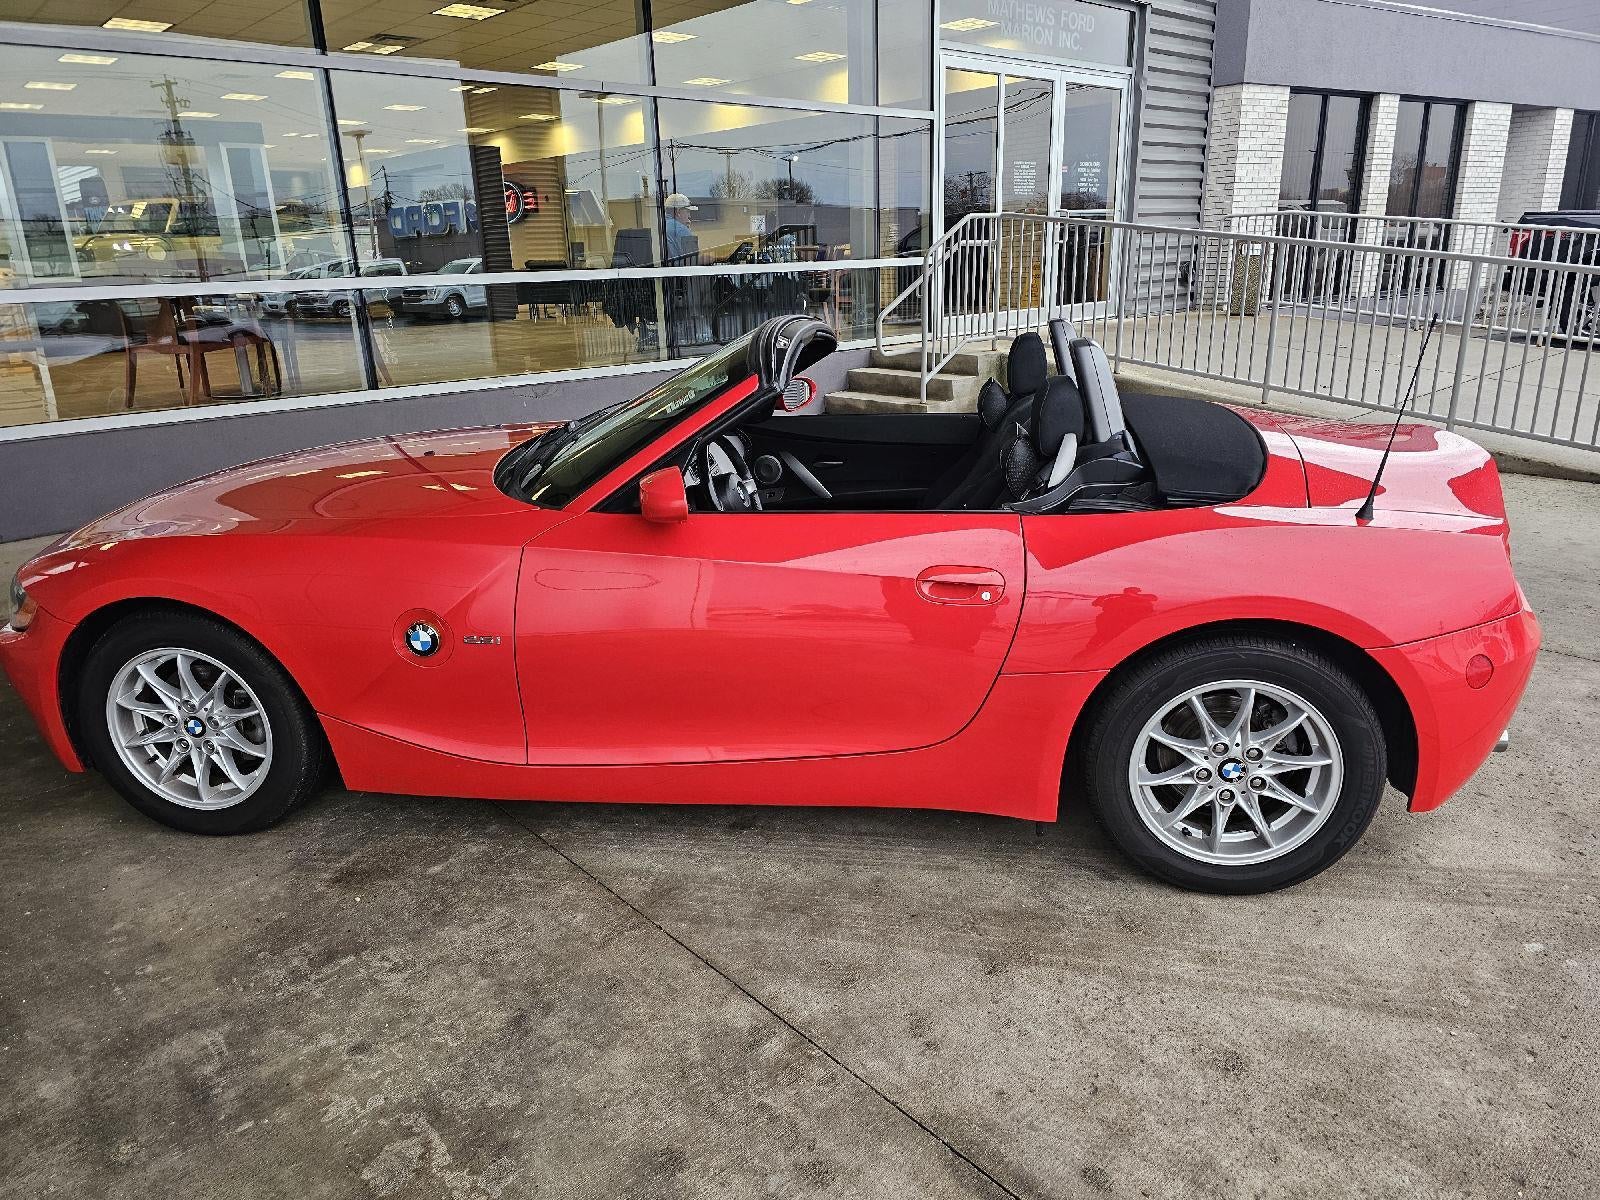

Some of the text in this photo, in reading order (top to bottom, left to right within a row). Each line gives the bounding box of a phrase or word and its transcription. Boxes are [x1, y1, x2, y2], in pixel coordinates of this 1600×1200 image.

[987, 0, 1096, 33] MATHEWS FORD
[1000, 20, 1083, 50] MARION INC.
